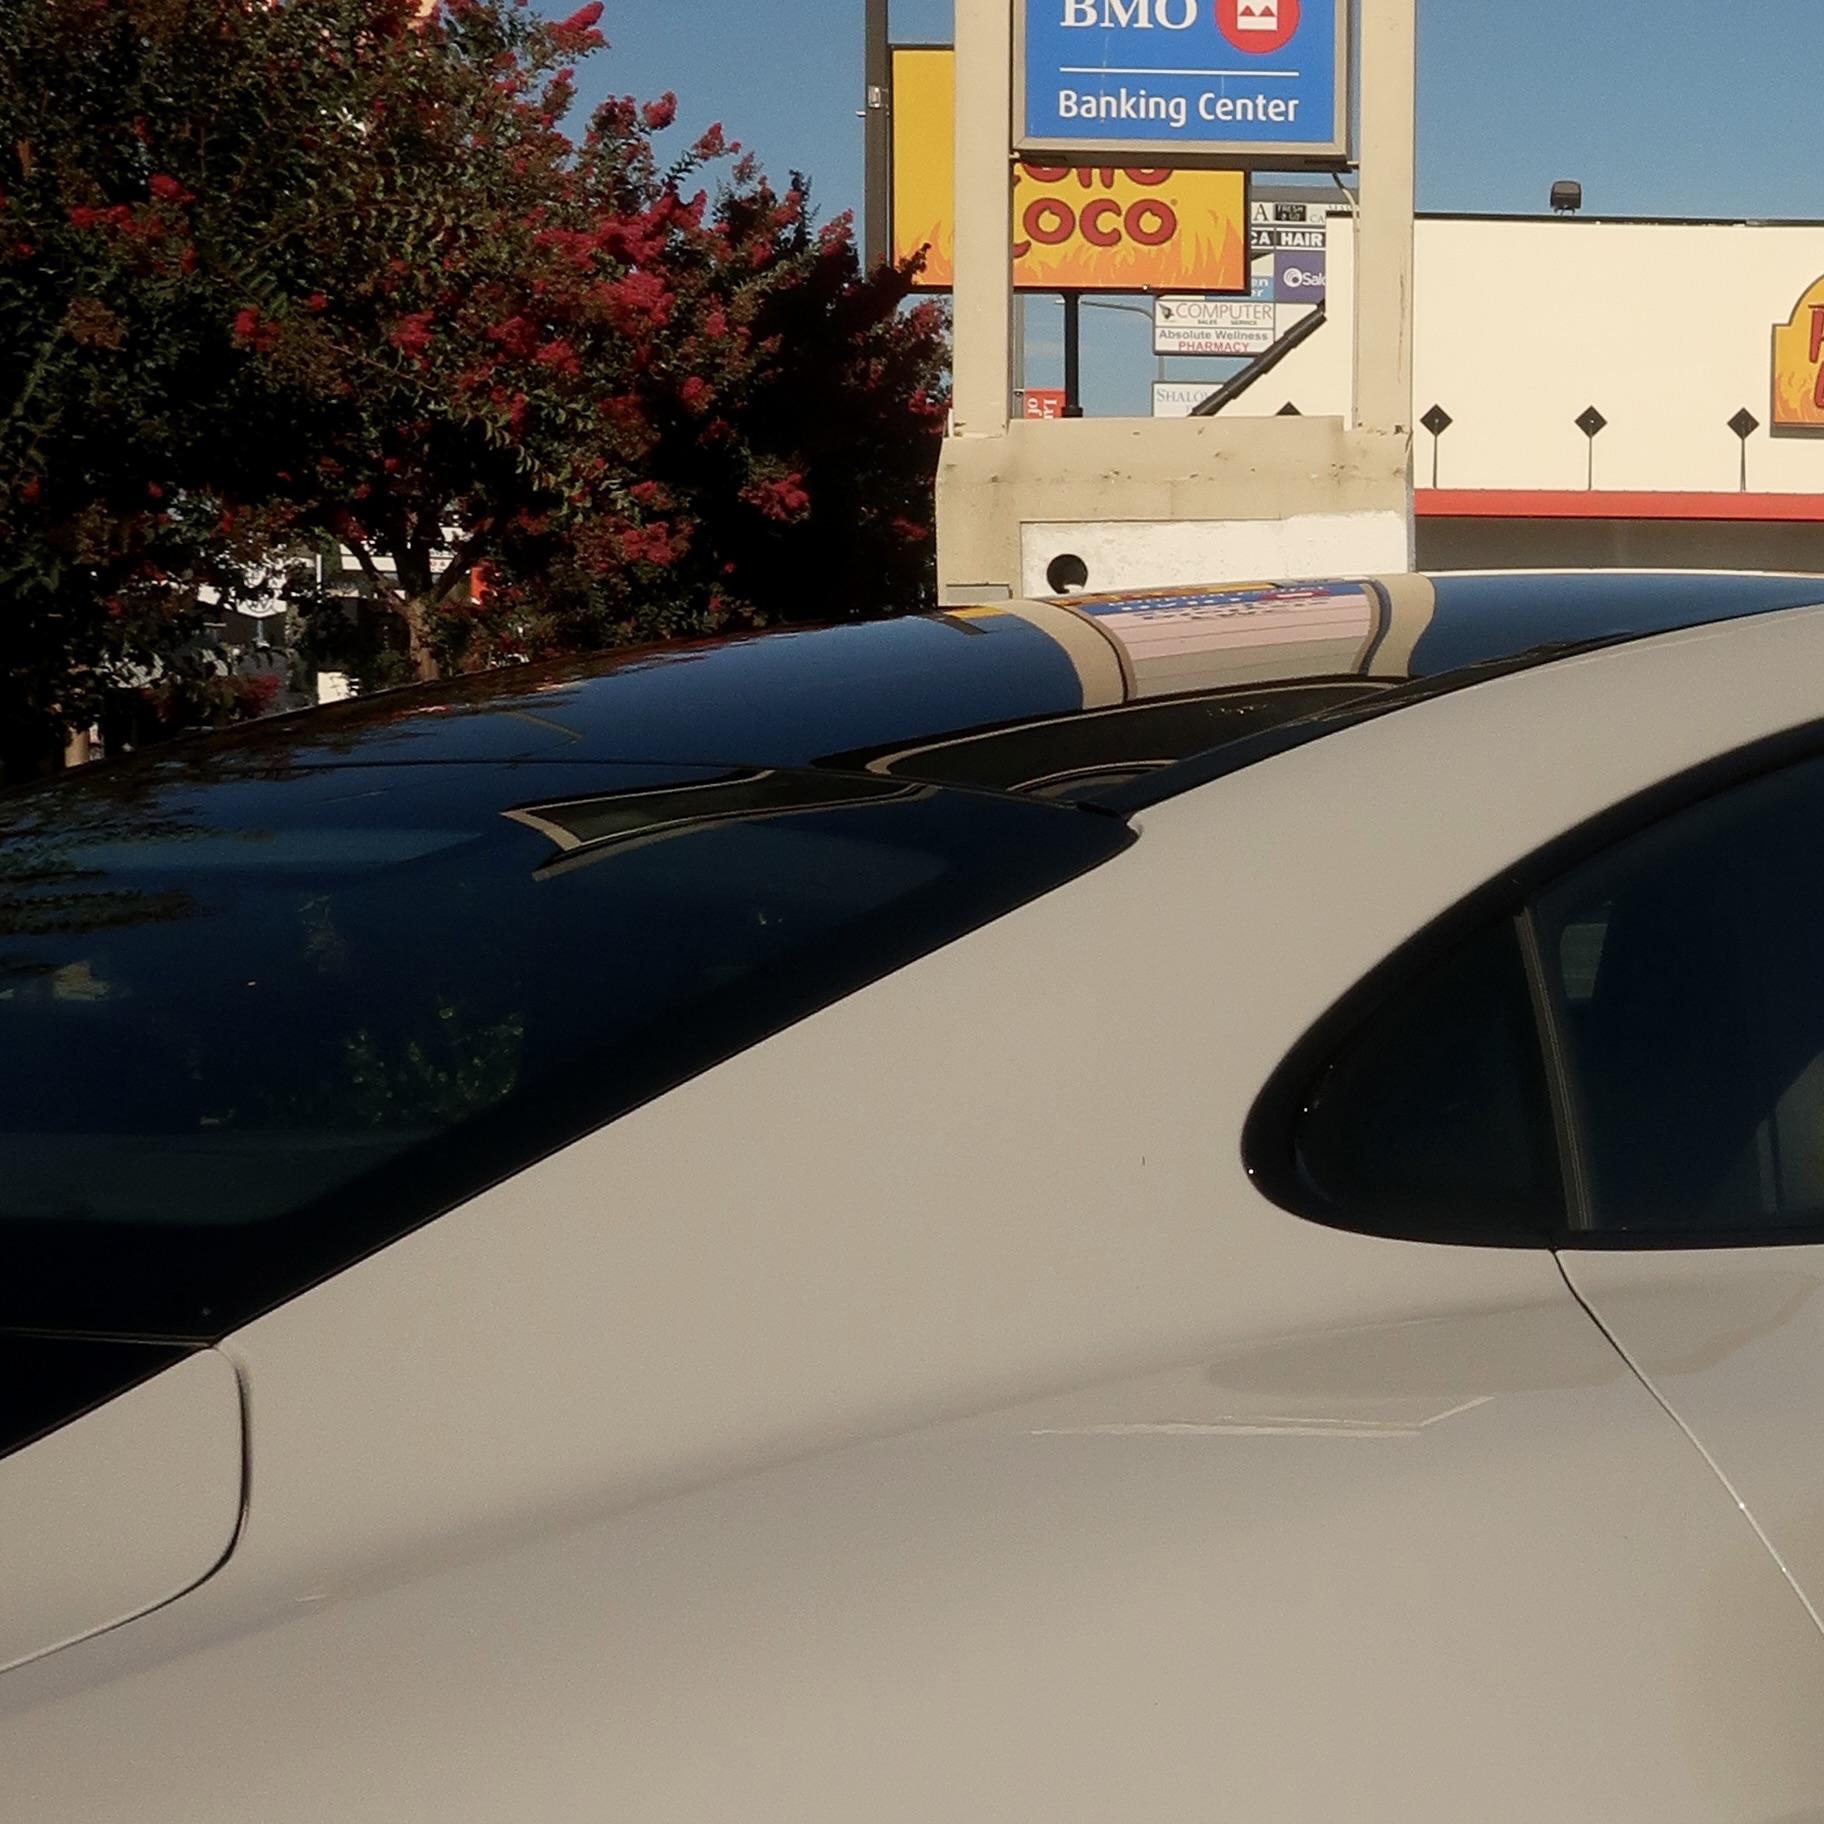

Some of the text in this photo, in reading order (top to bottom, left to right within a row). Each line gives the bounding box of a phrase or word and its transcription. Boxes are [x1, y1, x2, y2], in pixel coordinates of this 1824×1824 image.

[1058, 87, 1299, 127] Banking Center
[1014, 196, 1178, 259] oco
[1281, 231, 1323, 247] HAIR
[1175, 302, 1273, 320] COMPUTER
[1159, 329, 1268, 341] Absolute Wellness
[1177, 341, 1251, 353] PHARMACY
